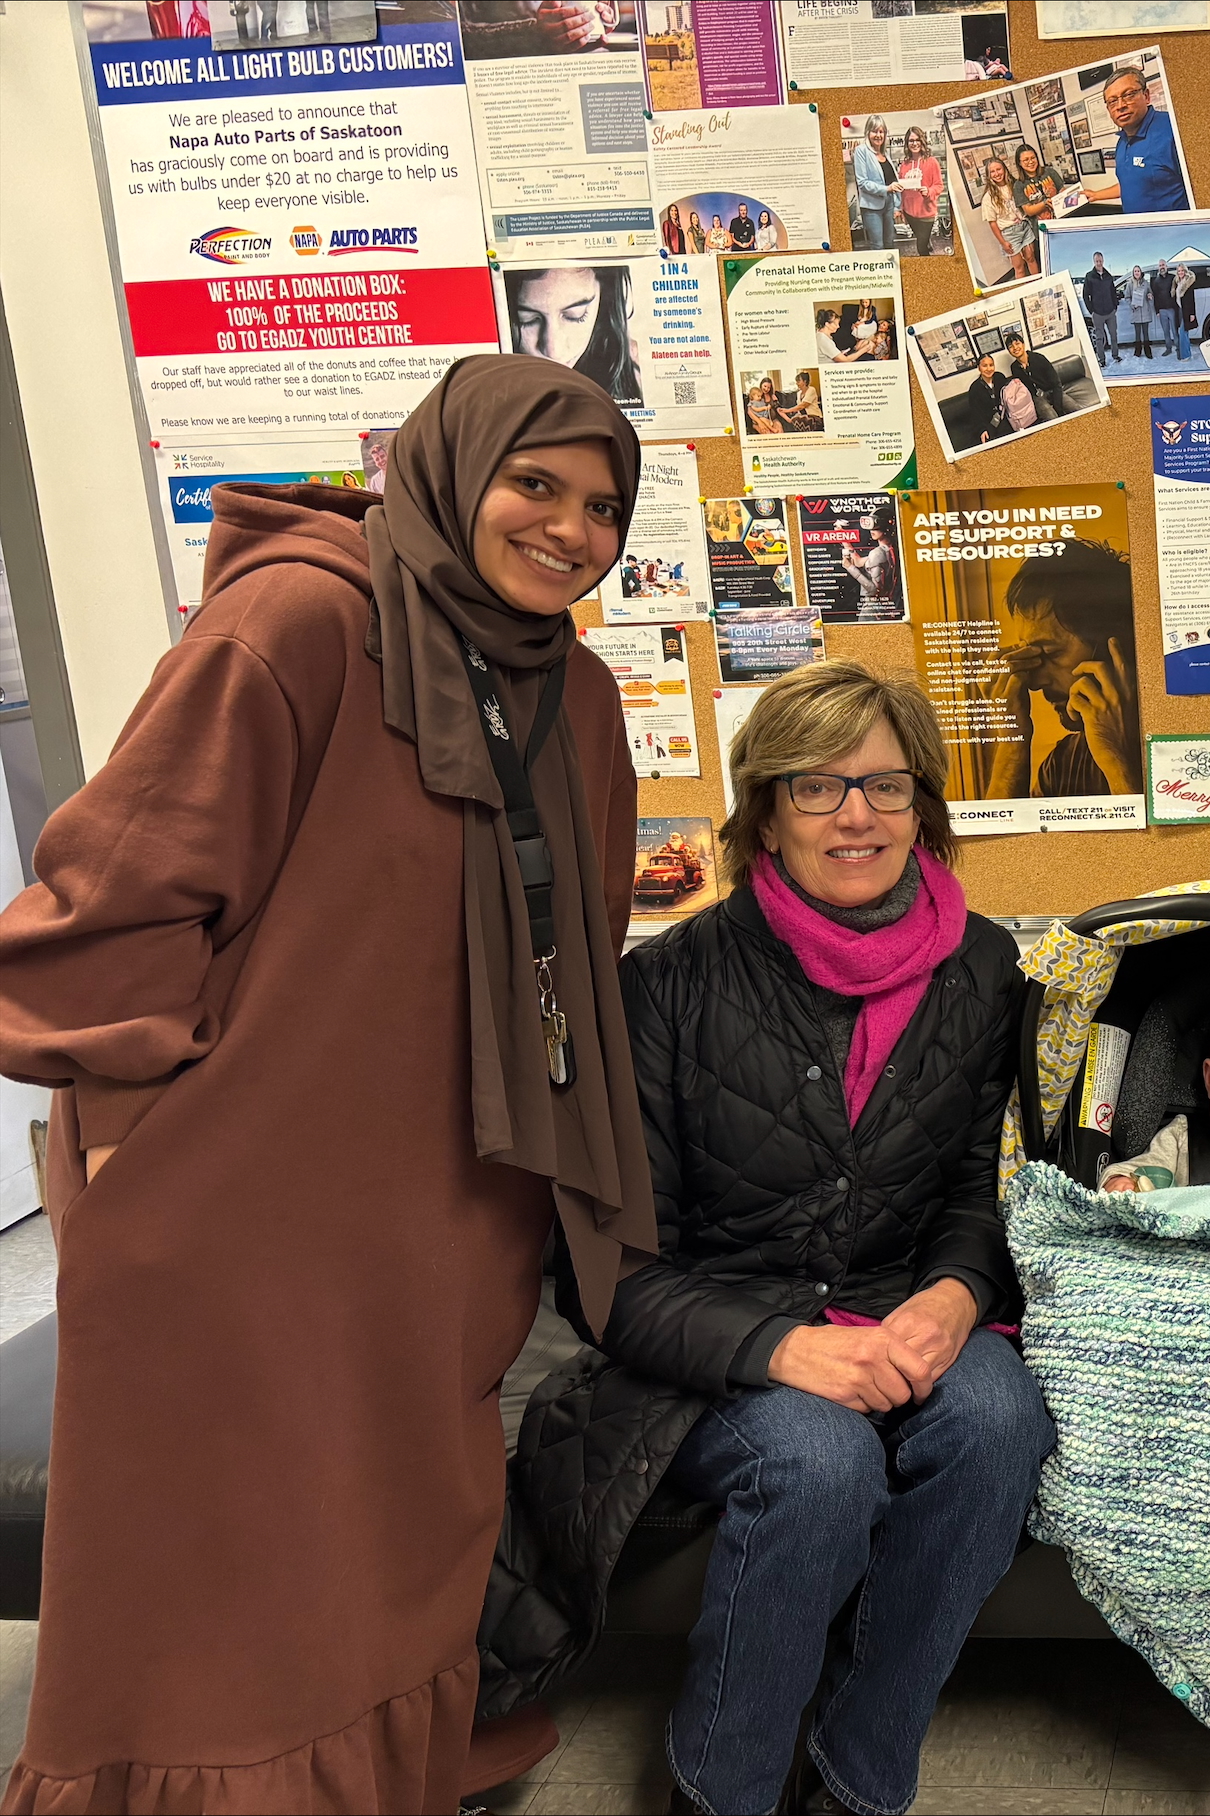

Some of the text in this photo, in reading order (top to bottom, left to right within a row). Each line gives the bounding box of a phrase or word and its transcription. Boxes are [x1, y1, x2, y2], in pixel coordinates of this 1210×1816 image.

[798, 0, 818, 8] LIFE
[798, 9, 818, 17] AFTER
[836, 7, 858, 15] CRISIS
[102, 42, 454, 88] WELCOME ALL LIGHT BULB CUSTOMERS!
[169, 101, 398, 127] We are pleased to announce that
[652, 111, 732, 146] Standing Out
[170, 125, 402, 151] Napa Auto Parts of Saskatoon
[130, 142, 449, 174] has graciously come on board and is providing
[129, 164, 458, 195] us with bulbs under $20 at no charge to help us
[218, 190, 369, 212] keep everyone visible.
[294, 233, 318, 248] NAPA
[330, 228, 418, 247] AUTO PARTS
[189, 237, 272, 254] PERFECTION
[660, 263, 688, 275] 1 IN 4
[756, 262, 894, 276] Prenatal Home Care Program
[207, 274, 406, 302] WE HAVE A DONATION BOX:
[652, 279, 698, 291] CHILDREN
[668, 295, 698, 303] affected
[226, 301, 398, 326] 100% OF THE PROCEEDS
[653, 309, 662, 317] by
[663, 321, 695, 329] drinking.
[217, 324, 413, 351] GO TO EGADZ YOUTH CENTRE
[694, 349, 712, 358] help.
[642, 463, 678, 476] Art Night
[782, 460, 805, 468] Authority
[651, 474, 682, 486] Modern
[830, 504, 877, 514] WORLD
[914, 505, 1102, 527] ARE YOU IN NEED
[806, 532, 857, 542] VR ARENA
[915, 524, 1076, 545] OF SUPPORT &
[185, 538, 208, 546] Sask
[916, 542, 1066, 562] RESOURCES?
[730, 626, 773, 638] Talking
[950, 810, 1014, 819] E:CONNECT
[1081, 1088, 1091, 1120] WARNING
[1089, 1049, 1096, 1059] EN
